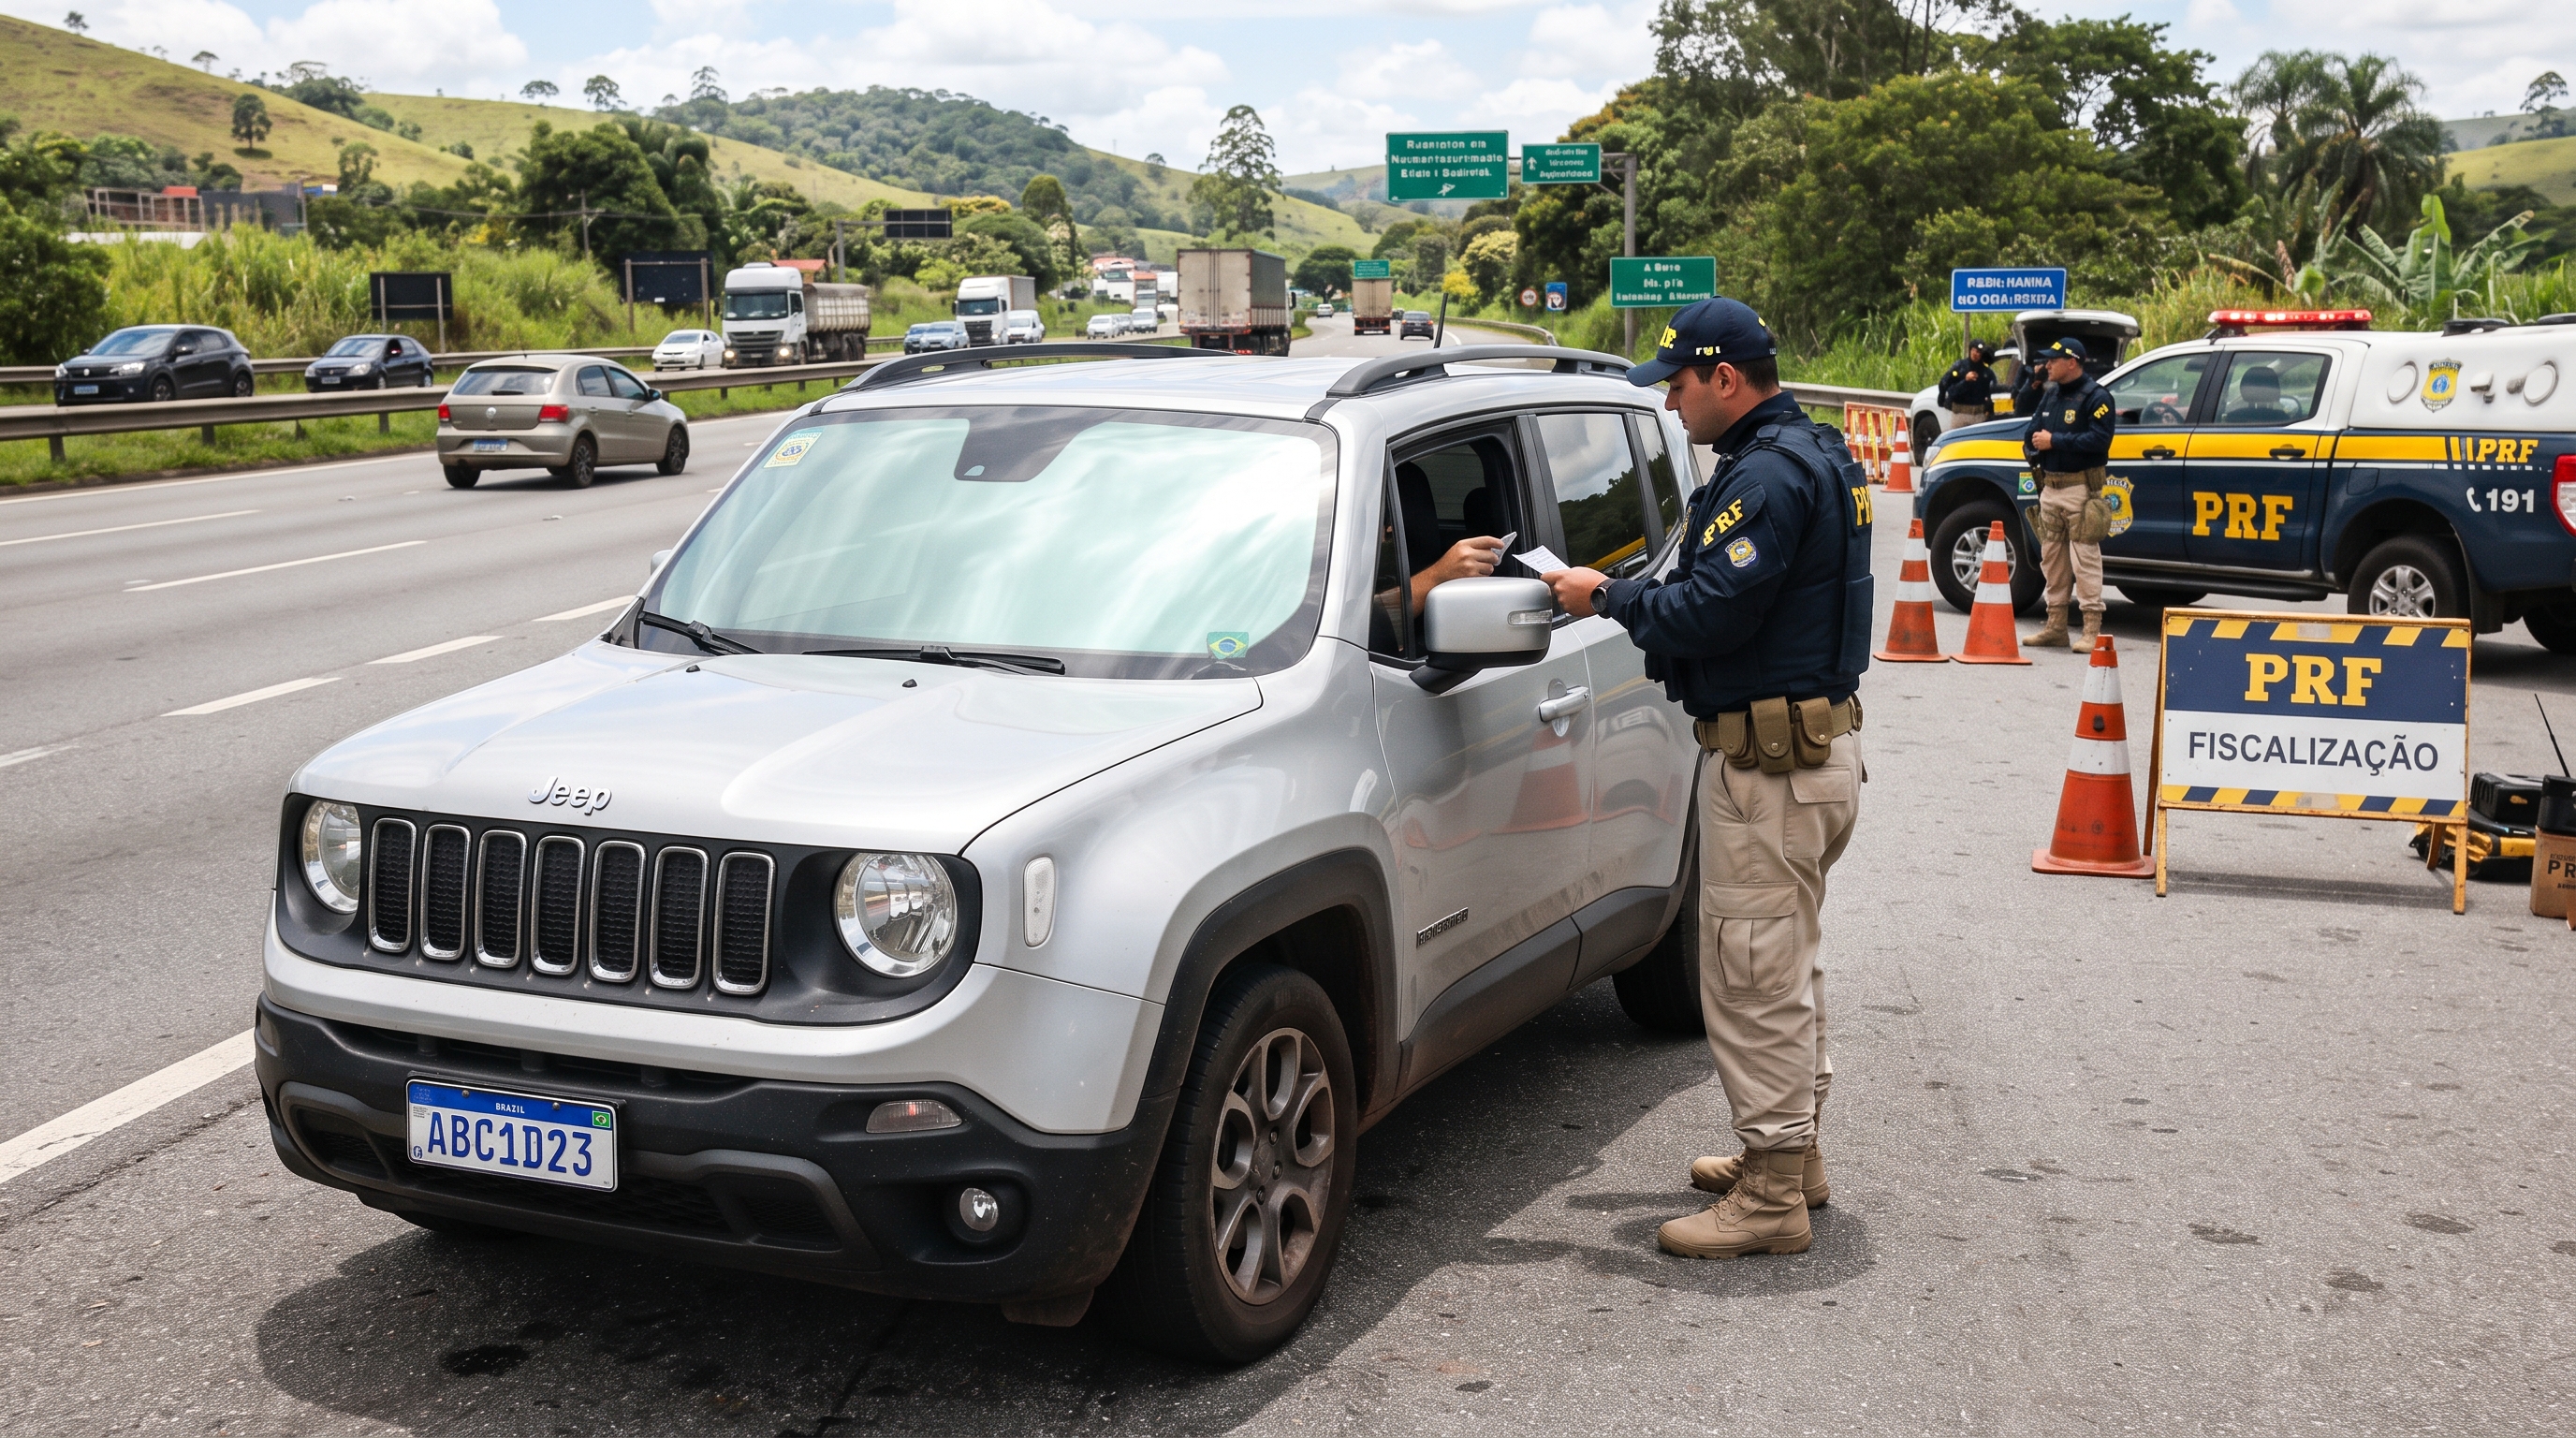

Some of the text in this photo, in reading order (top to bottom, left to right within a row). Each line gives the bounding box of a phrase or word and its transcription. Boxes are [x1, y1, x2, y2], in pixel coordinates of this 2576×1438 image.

[2476, 438, 2539, 462] PRF
[1703, 499, 1743, 547] PRF
[2192, 492, 2293, 540] PRF
[2486, 488, 2535, 513] 191
[2245, 653, 2382, 706] PRF
[2188, 731, 2438, 776] FISCALIZAÇÃO
[528, 776, 612, 816] Jeep
[495, 1102, 525, 1114] BRAZIL
[428, 1111, 592, 1177] ABC1D23
